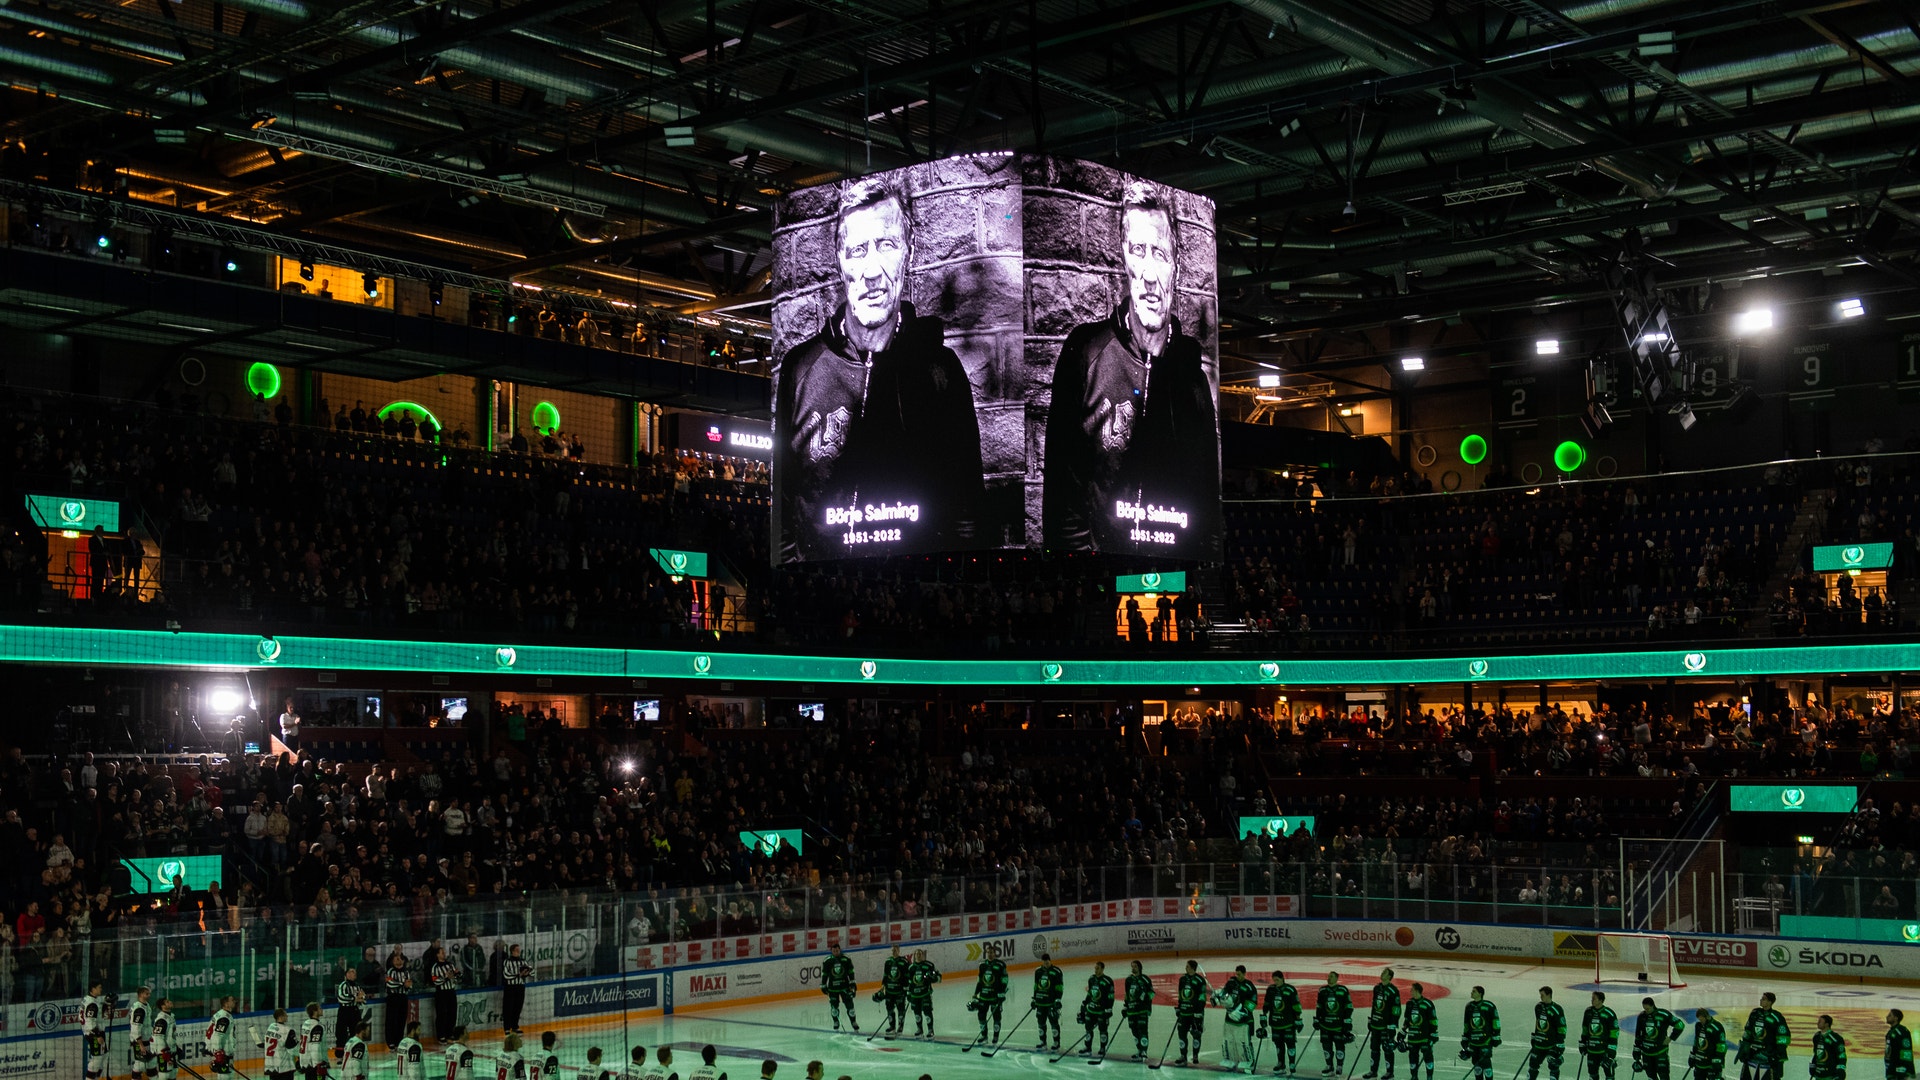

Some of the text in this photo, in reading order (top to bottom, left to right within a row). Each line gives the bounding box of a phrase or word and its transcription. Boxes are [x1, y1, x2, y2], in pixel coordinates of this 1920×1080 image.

[1804, 356, 1820, 386] 9
[1511, 388, 1526, 416] 2
[826, 501, 919, 527] Börje Salming
[1116, 501, 1187, 528] Börje Salming
[843, 529, 901, 544] 1951-2022
[1130, 529, 1175, 544] 1951-2022
[1225, 927, 1291, 939] PUTS TEGEL
[1324, 929, 1392, 942] Swedbank
[1437, 931, 1458, 945] ISS
[1660, 940, 1747, 957] BEVEGO
[1799, 948, 1883, 968] ŠKODA
[690, 975, 727, 992] MAXI
[562, 990, 589, 1006] Max
[40, 1060, 55, 1070] AB
